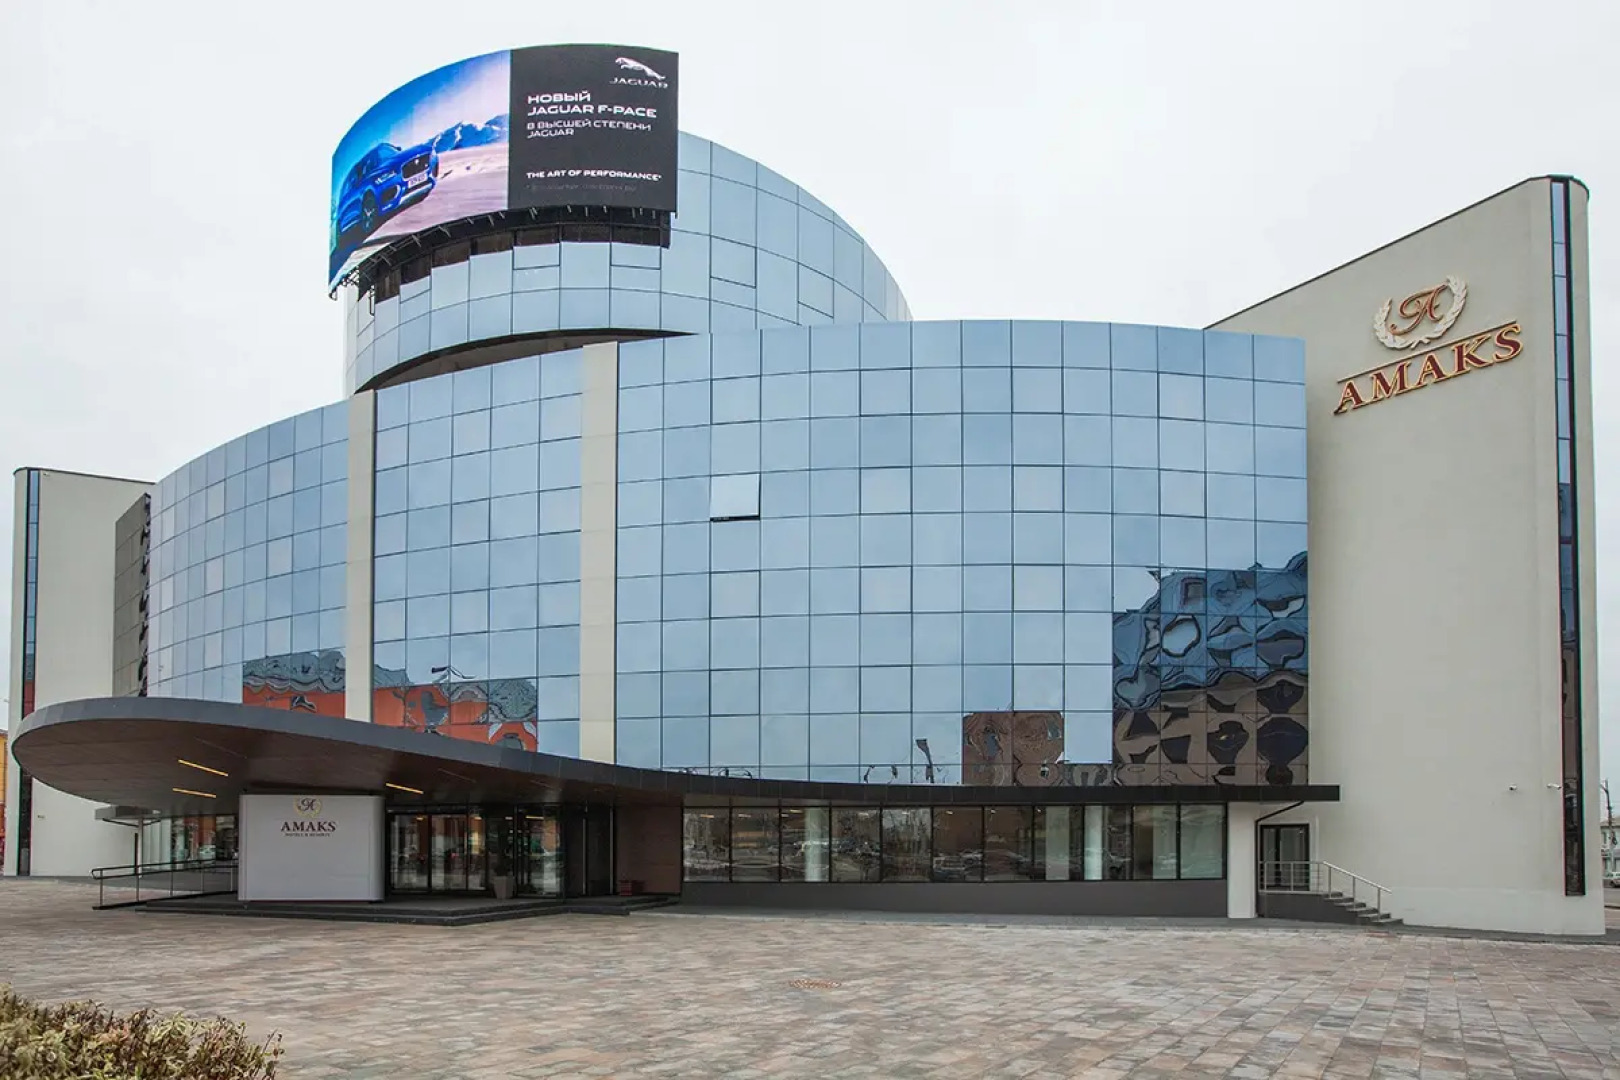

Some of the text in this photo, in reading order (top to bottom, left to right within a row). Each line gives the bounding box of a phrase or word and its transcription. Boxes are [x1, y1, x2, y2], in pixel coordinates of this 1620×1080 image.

[609, 77, 668, 89] JAGUAR
[527, 90, 591, 104] НОВЫЙ
[527, 104, 657, 118] JAGUAR F-PACE
[527, 119, 651, 132] В ВЫСШЕЙ СТЕПЕНИ
[527, 128, 575, 139] JAGUAR
[526, 171, 545, 180] THE
[547, 169, 566, 178] ART
[567, 169, 582, 177] OF
[1333, 322, 1524, 416] AMAKS
[281, 821, 336, 832] AMAKS
